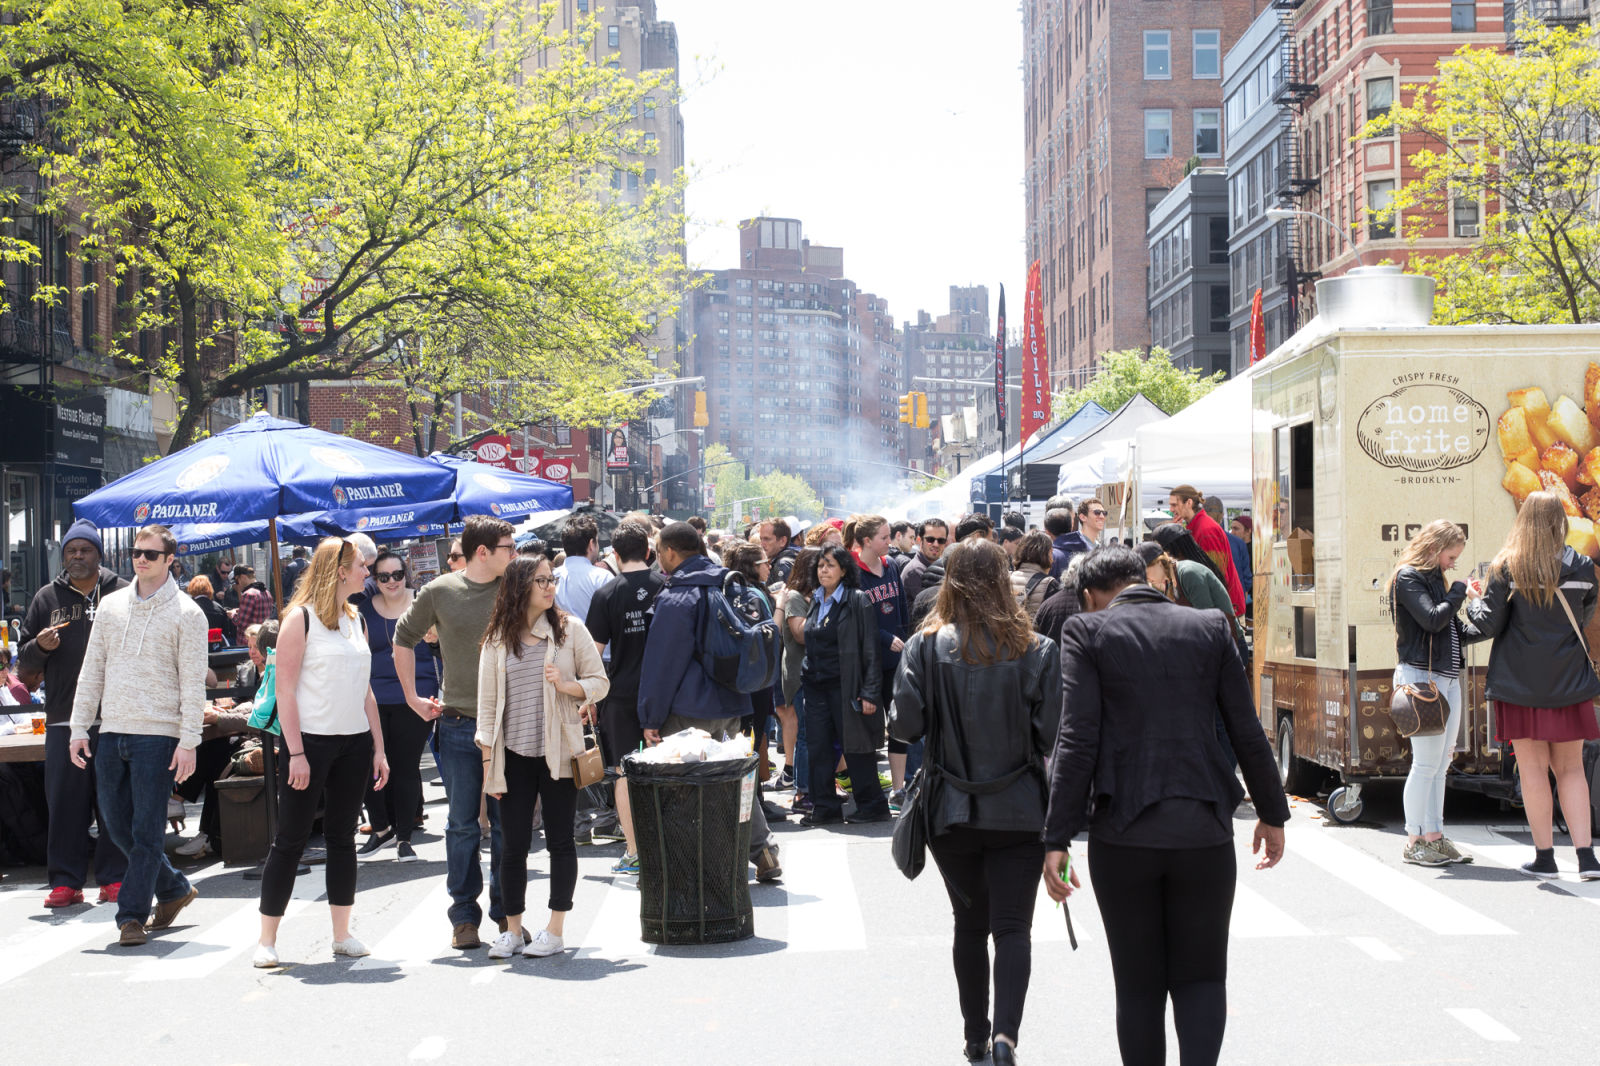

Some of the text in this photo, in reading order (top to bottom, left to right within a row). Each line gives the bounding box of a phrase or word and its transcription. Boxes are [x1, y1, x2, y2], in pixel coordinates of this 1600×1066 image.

[1392, 372, 1460, 386] CRISPY FRESH
[1385, 400, 1468, 424] home
[1385, 428, 1470, 455] frite
[481, 444, 503, 459] NYSC
[56, 472, 88, 484] Custom
[66, 485, 98, 497] Framin
[346, 482, 405, 501] PAULANER
[151, 502, 218, 519] PAULANER
[499, 498, 541, 513] PAULANER
[368, 511, 415, 527] PAULANER
[189, 537, 231, 552] PAULANER
[625, 610, 642, 619] PAIN
